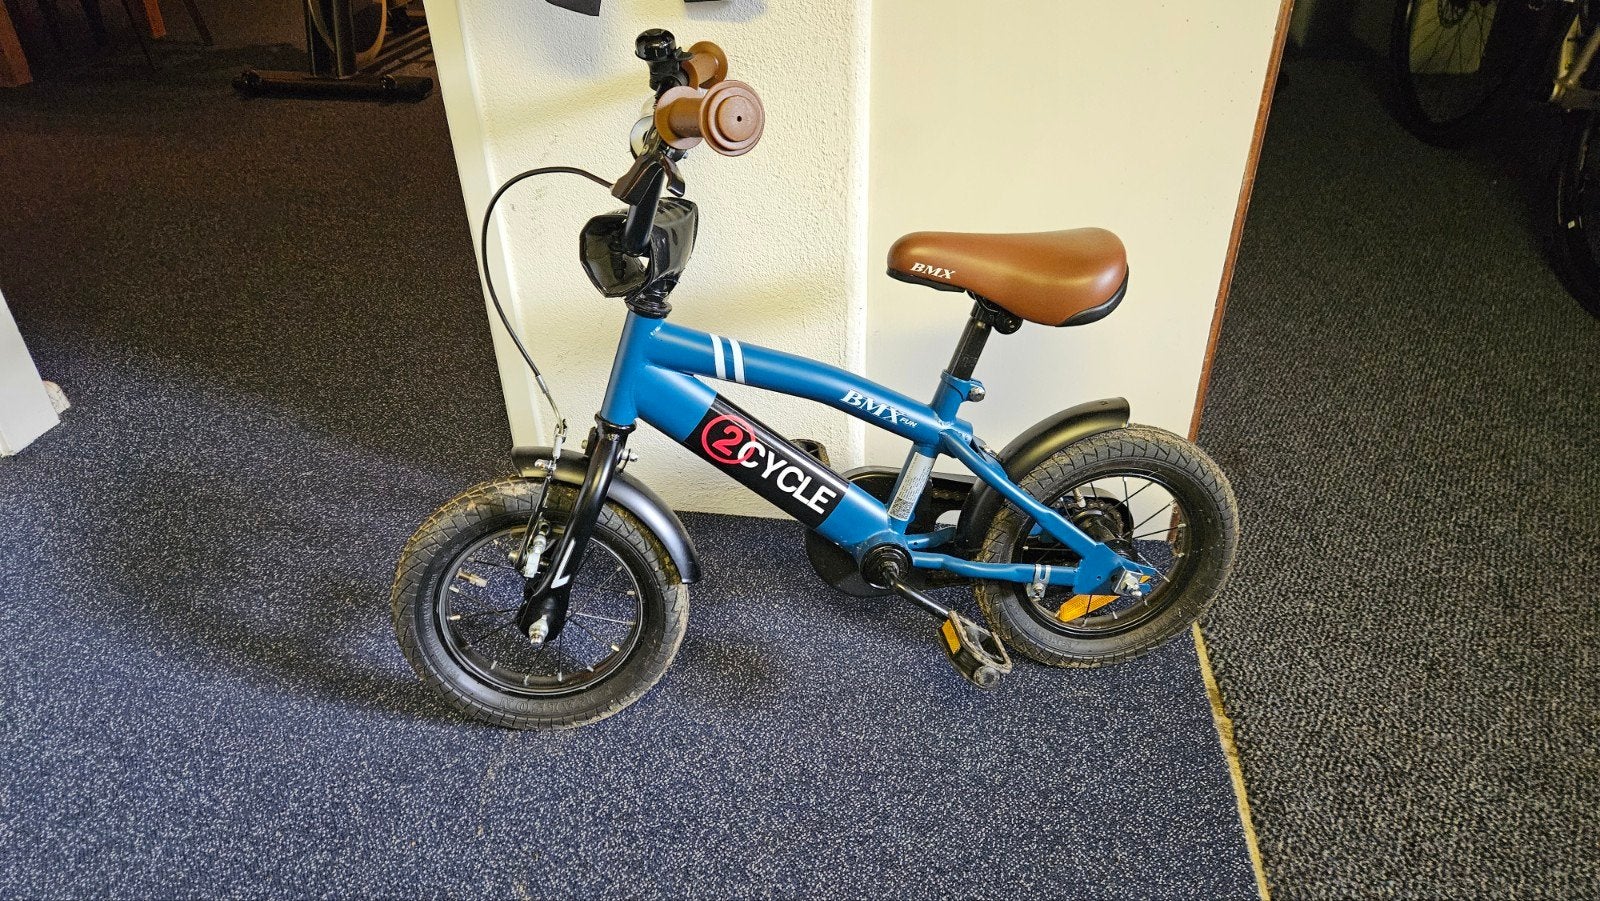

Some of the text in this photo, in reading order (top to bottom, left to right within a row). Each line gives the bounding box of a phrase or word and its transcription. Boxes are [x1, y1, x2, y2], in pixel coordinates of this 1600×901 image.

[910, 262, 956, 279] BMX
[840, 389, 918, 428] BMX FUN
